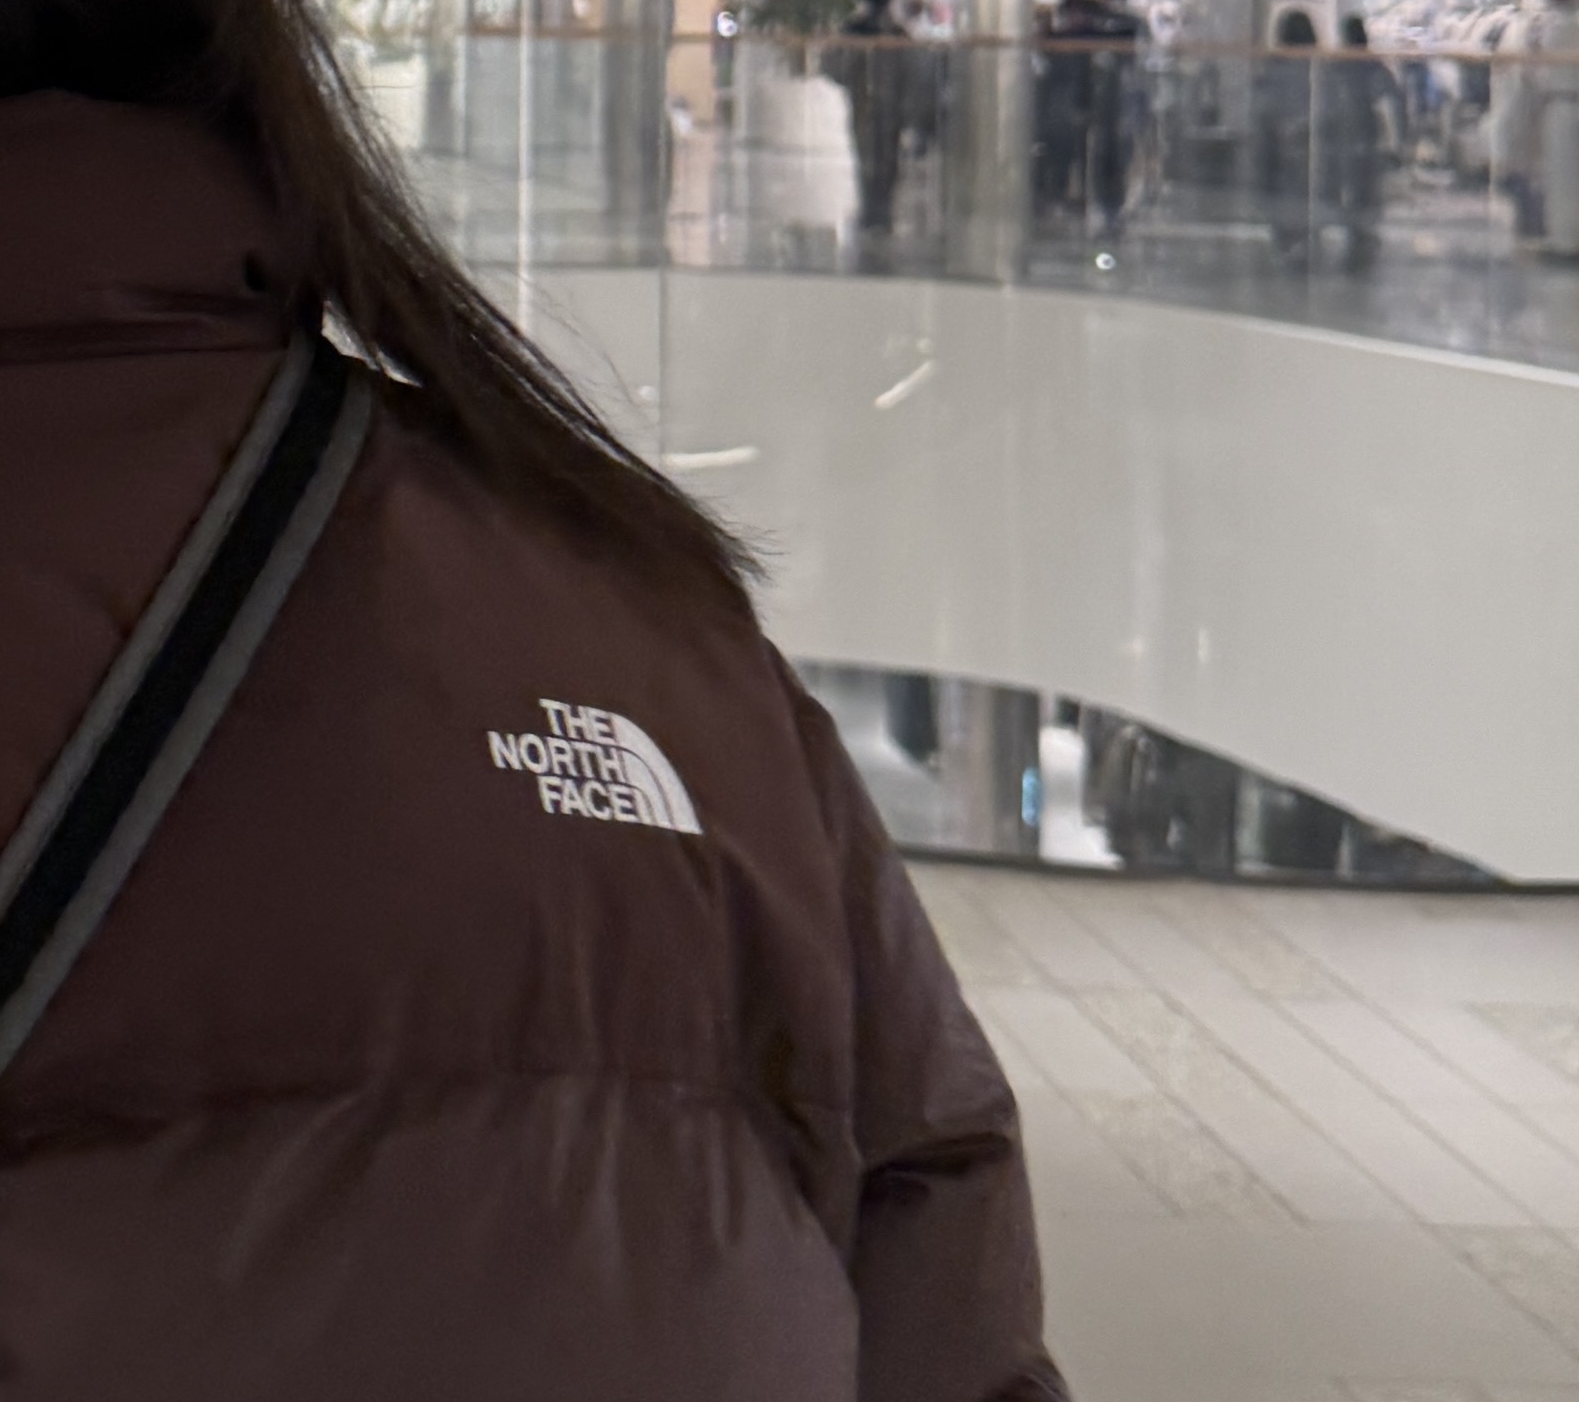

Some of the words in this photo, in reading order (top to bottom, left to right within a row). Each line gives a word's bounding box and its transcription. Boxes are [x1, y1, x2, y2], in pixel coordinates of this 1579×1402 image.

[538, 698, 617, 745] THE
[487, 730, 626, 783] NORTH
[537, 775, 638, 823] FACE
